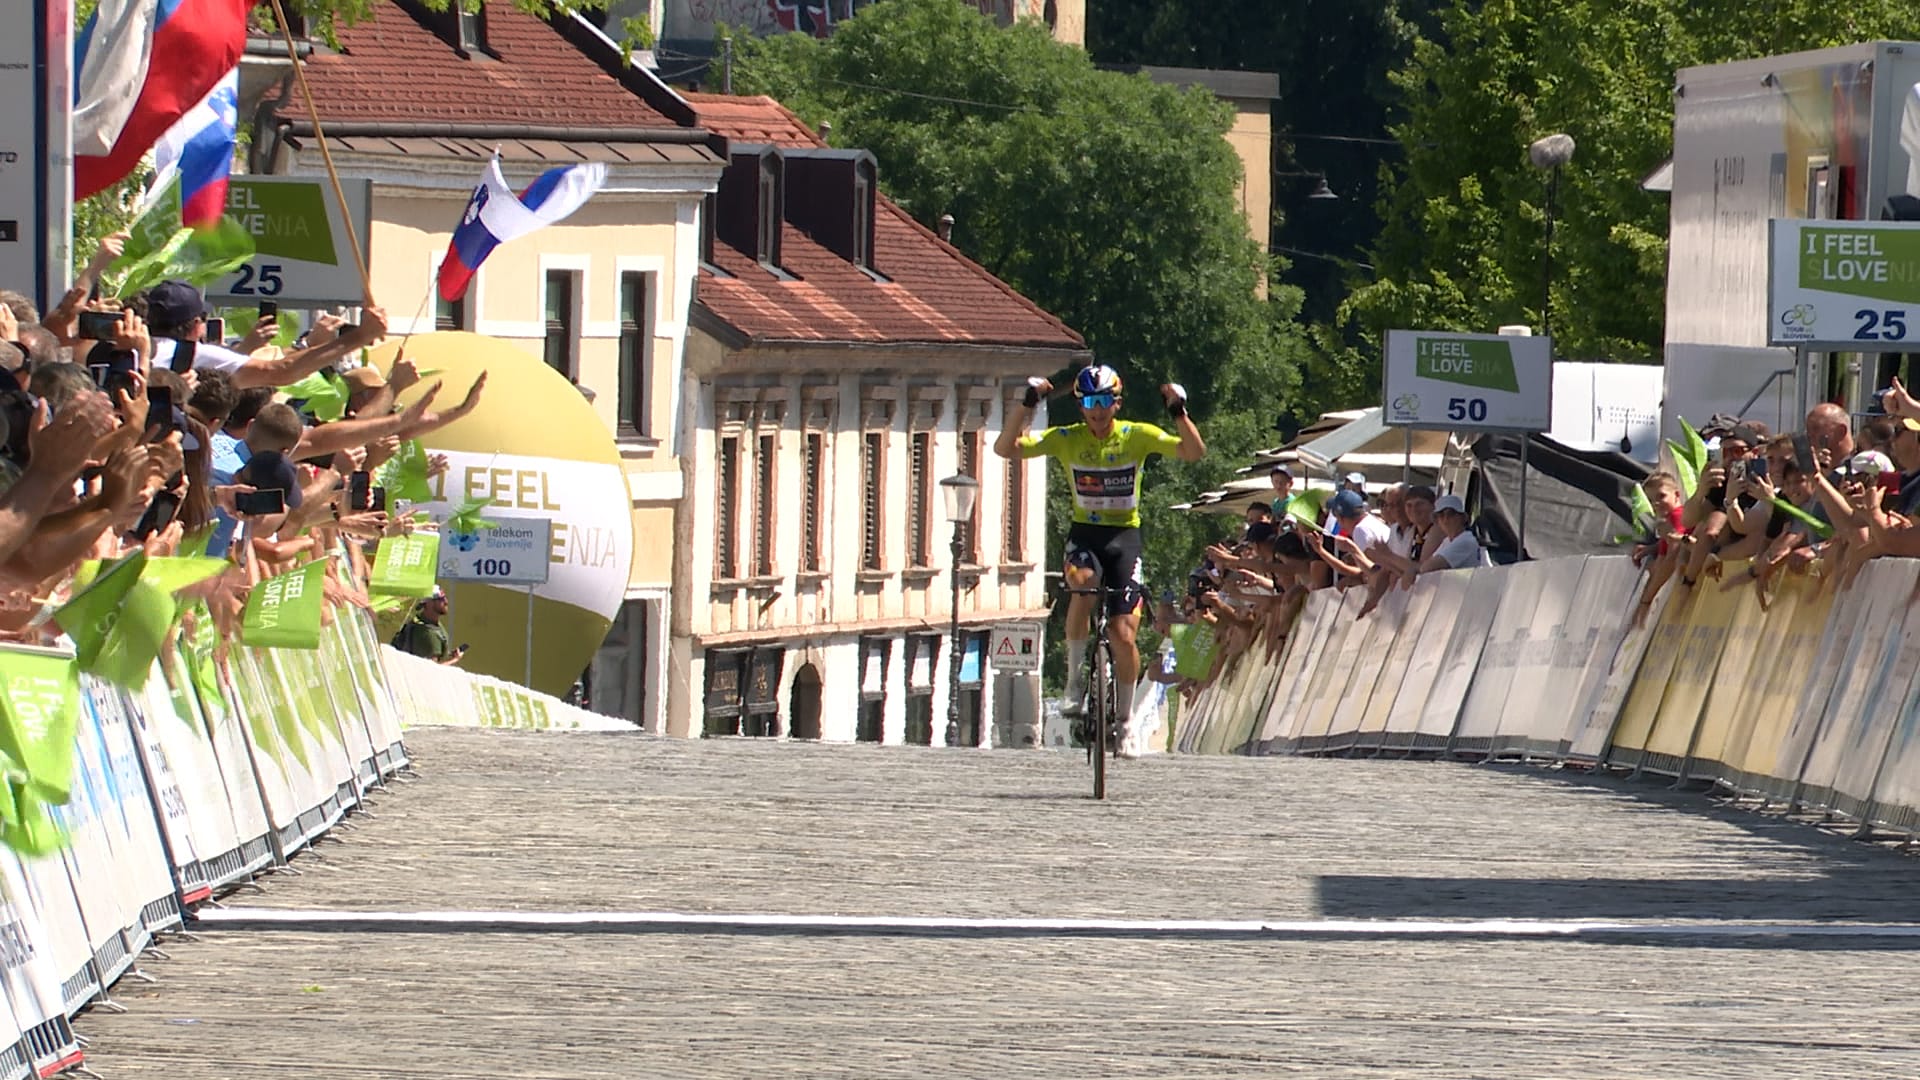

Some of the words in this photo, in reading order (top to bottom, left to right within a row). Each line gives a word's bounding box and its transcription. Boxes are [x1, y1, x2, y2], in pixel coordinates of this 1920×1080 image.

[1806, 233, 1817, 254] I
[1824, 233, 1884, 256] FEEL
[230, 264, 283, 295] 25
[1807, 258, 1920, 283] SLOVENI
[1853, 309, 1907, 341] 25
[1420, 342, 1428, 356] I
[1432, 342, 1470, 357] FEEL
[1447, 398, 1488, 422] 50
[465, 466, 561, 511] FEEL
[1104, 475, 1134, 486] BORA
[487, 526, 534, 538] Telekom
[550, 523, 617, 569] ENIA
[472, 558, 512, 576] 100
[284, 575, 305, 603] FEEL
